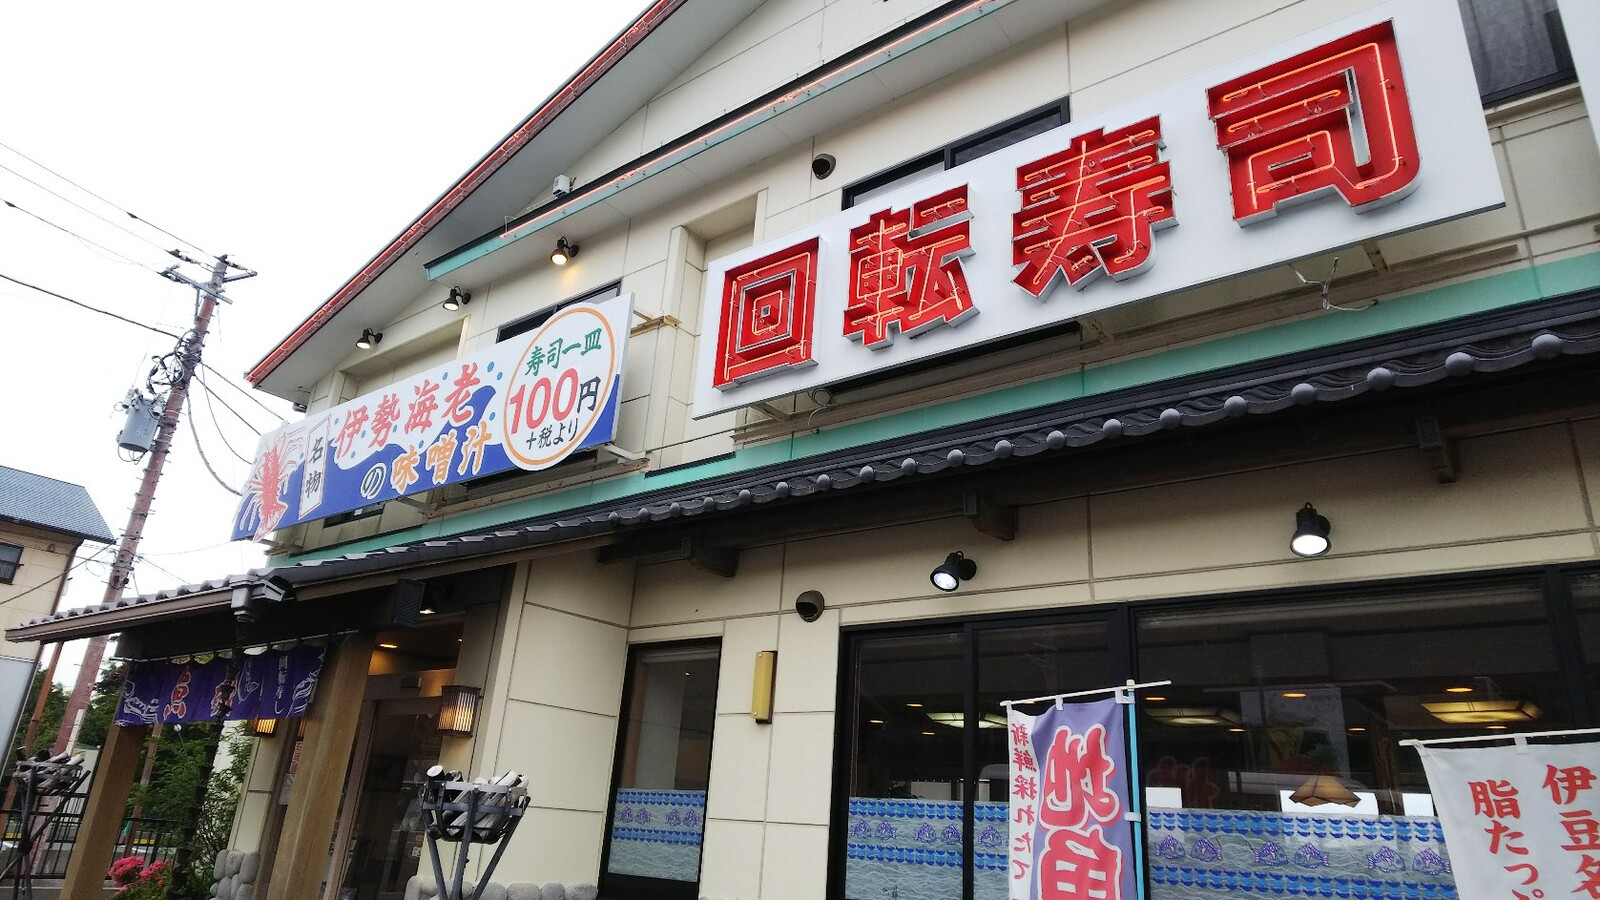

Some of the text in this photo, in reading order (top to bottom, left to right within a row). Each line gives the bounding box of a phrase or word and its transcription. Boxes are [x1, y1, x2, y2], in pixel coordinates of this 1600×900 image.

[714, 18, 1421, 390] 回転寿司
[524, 327, 602, 377] 寿司一皿
[334, 362, 481, 459] 伊勢海老
[509, 368, 602, 435] 100円
[304, 436, 324, 498] 名物
[361, 420, 493, 497] の味噌汁
